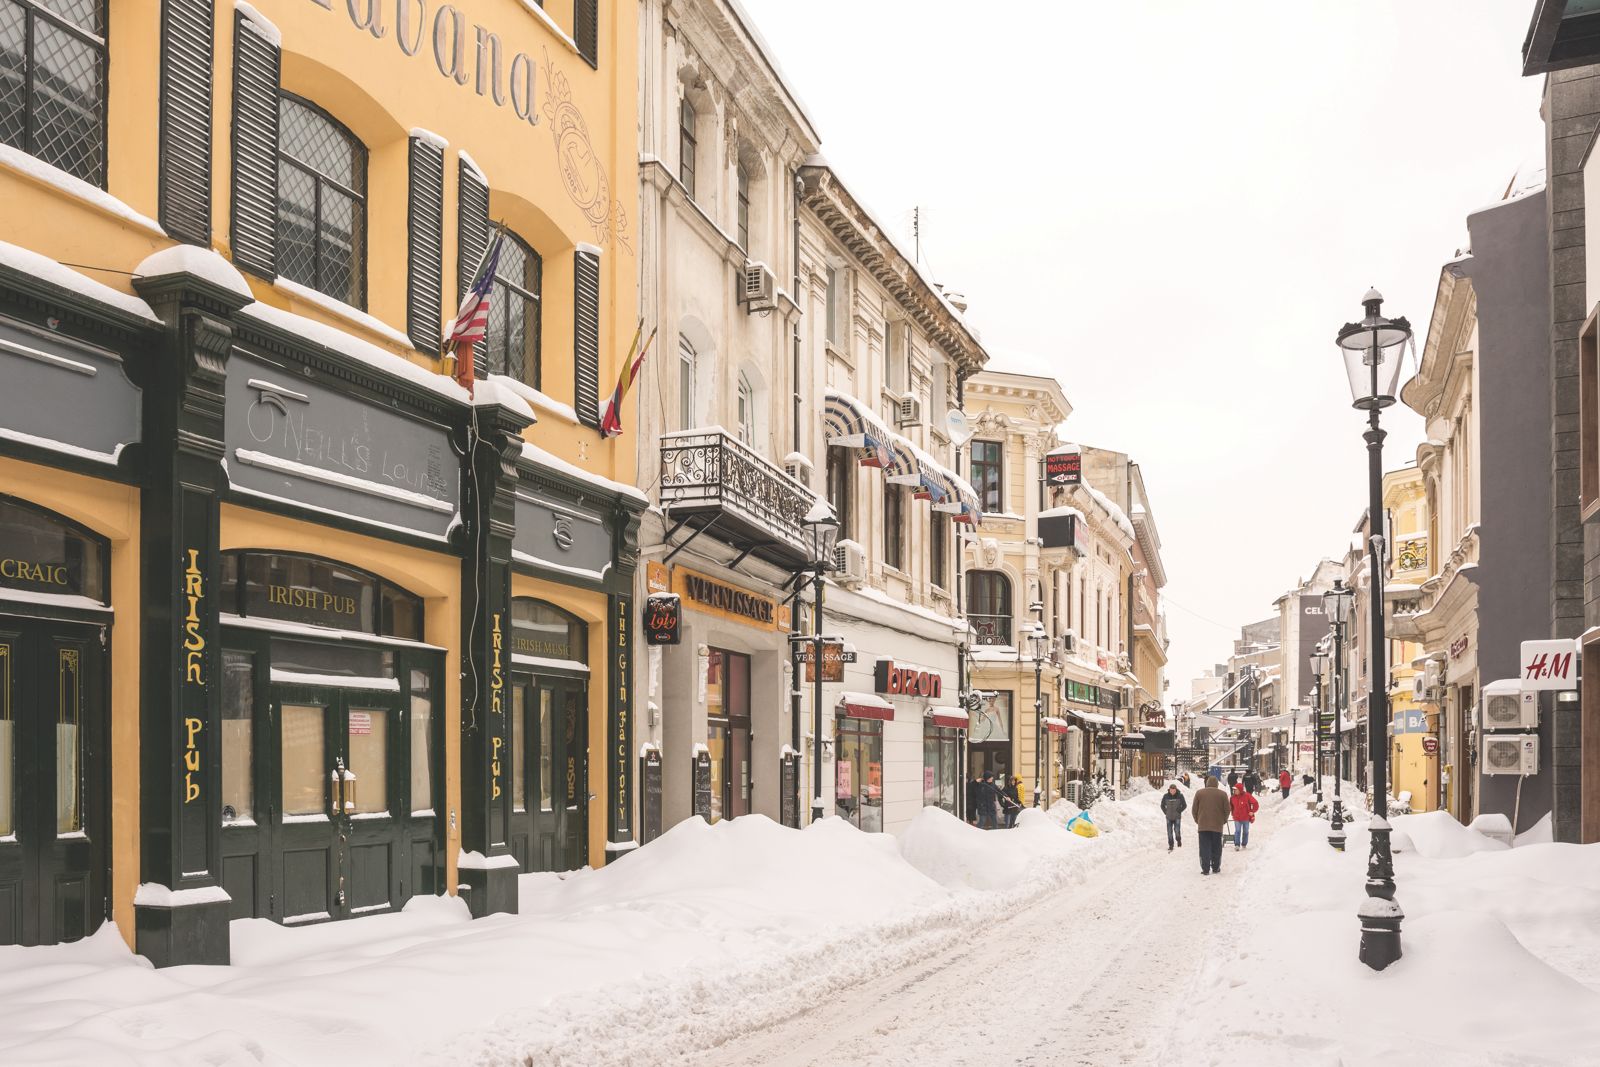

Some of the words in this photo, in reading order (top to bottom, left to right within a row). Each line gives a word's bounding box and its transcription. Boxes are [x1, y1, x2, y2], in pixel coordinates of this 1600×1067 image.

[309, 0, 539, 126] vana
[1047, 463, 1080, 473] MASSAGE
[0, 558, 68, 585] CRAIC
[269, 584, 317, 609] IRISH
[323, 593, 356, 616] PUB
[685, 574, 774, 624] VERNISSAGE
[618, 601, 626, 648] THE
[516, 638, 542, 653] IRISH
[795, 652, 854, 662] VERSSAGE
[886, 660, 942, 699] bizon
[1525, 652, 1572, 681] H&M
